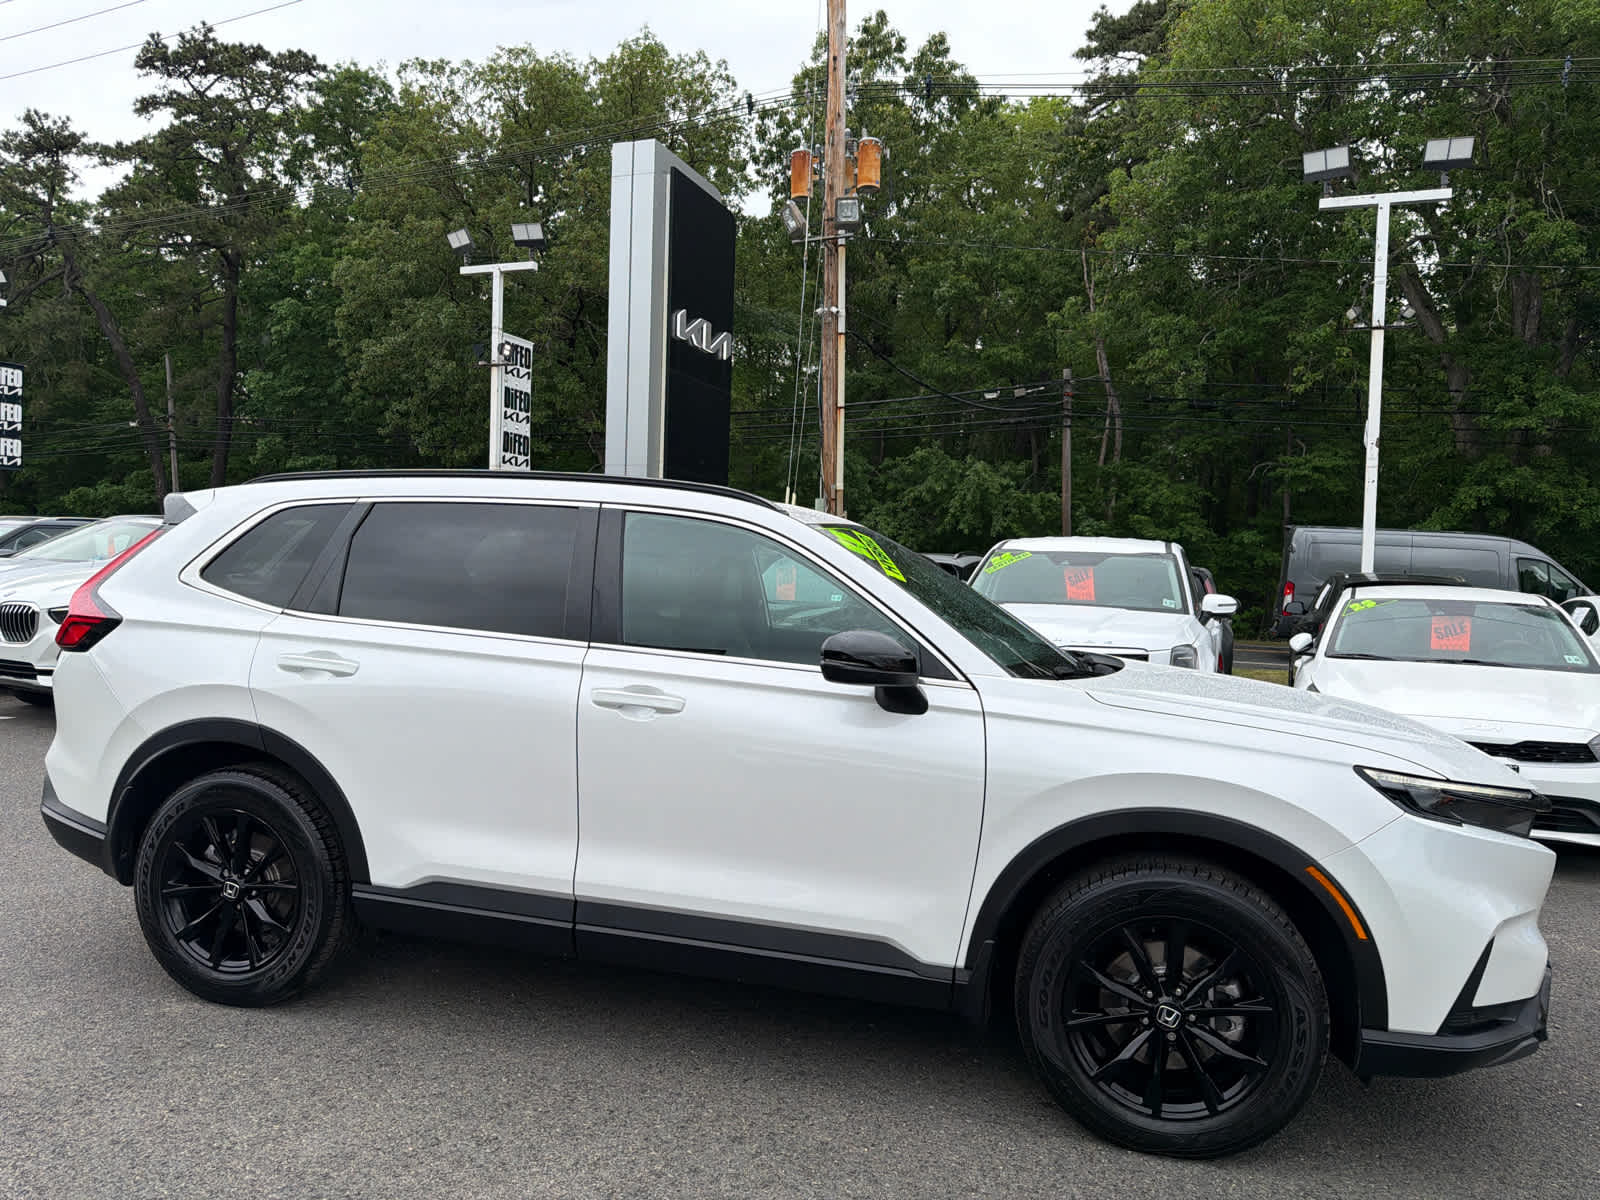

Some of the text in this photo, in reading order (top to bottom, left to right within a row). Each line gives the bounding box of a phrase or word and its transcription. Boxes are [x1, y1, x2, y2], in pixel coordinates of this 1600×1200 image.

[674, 309, 733, 361] KIA
[504, 366, 531, 380] KIA
[503, 410, 530, 424] KIA
[502, 454, 529, 468] KIA
[1433, 622, 1467, 640] SALE
